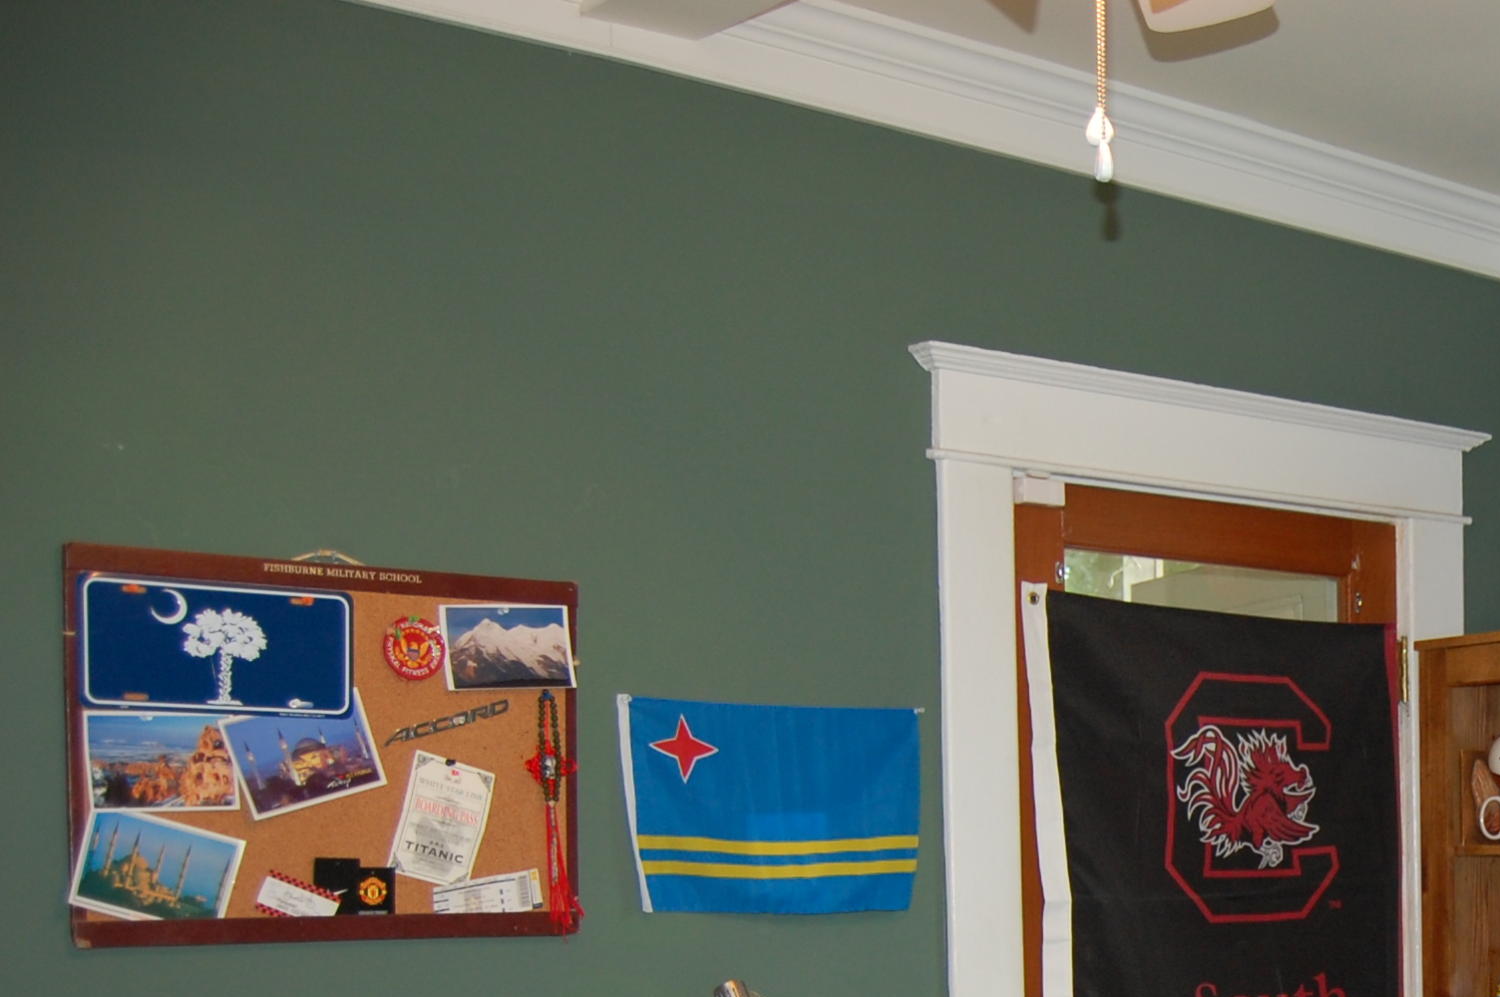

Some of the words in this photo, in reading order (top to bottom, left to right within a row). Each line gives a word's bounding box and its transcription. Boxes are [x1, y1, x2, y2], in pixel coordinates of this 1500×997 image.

[263, 563, 324, 576] FISHBURNE
[326, 568, 377, 581] MILITARY
[379, 573, 423, 584] SCHOOL
[384, 699, 510, 748] ACCORD
[405, 840, 464, 864] TITANIC
